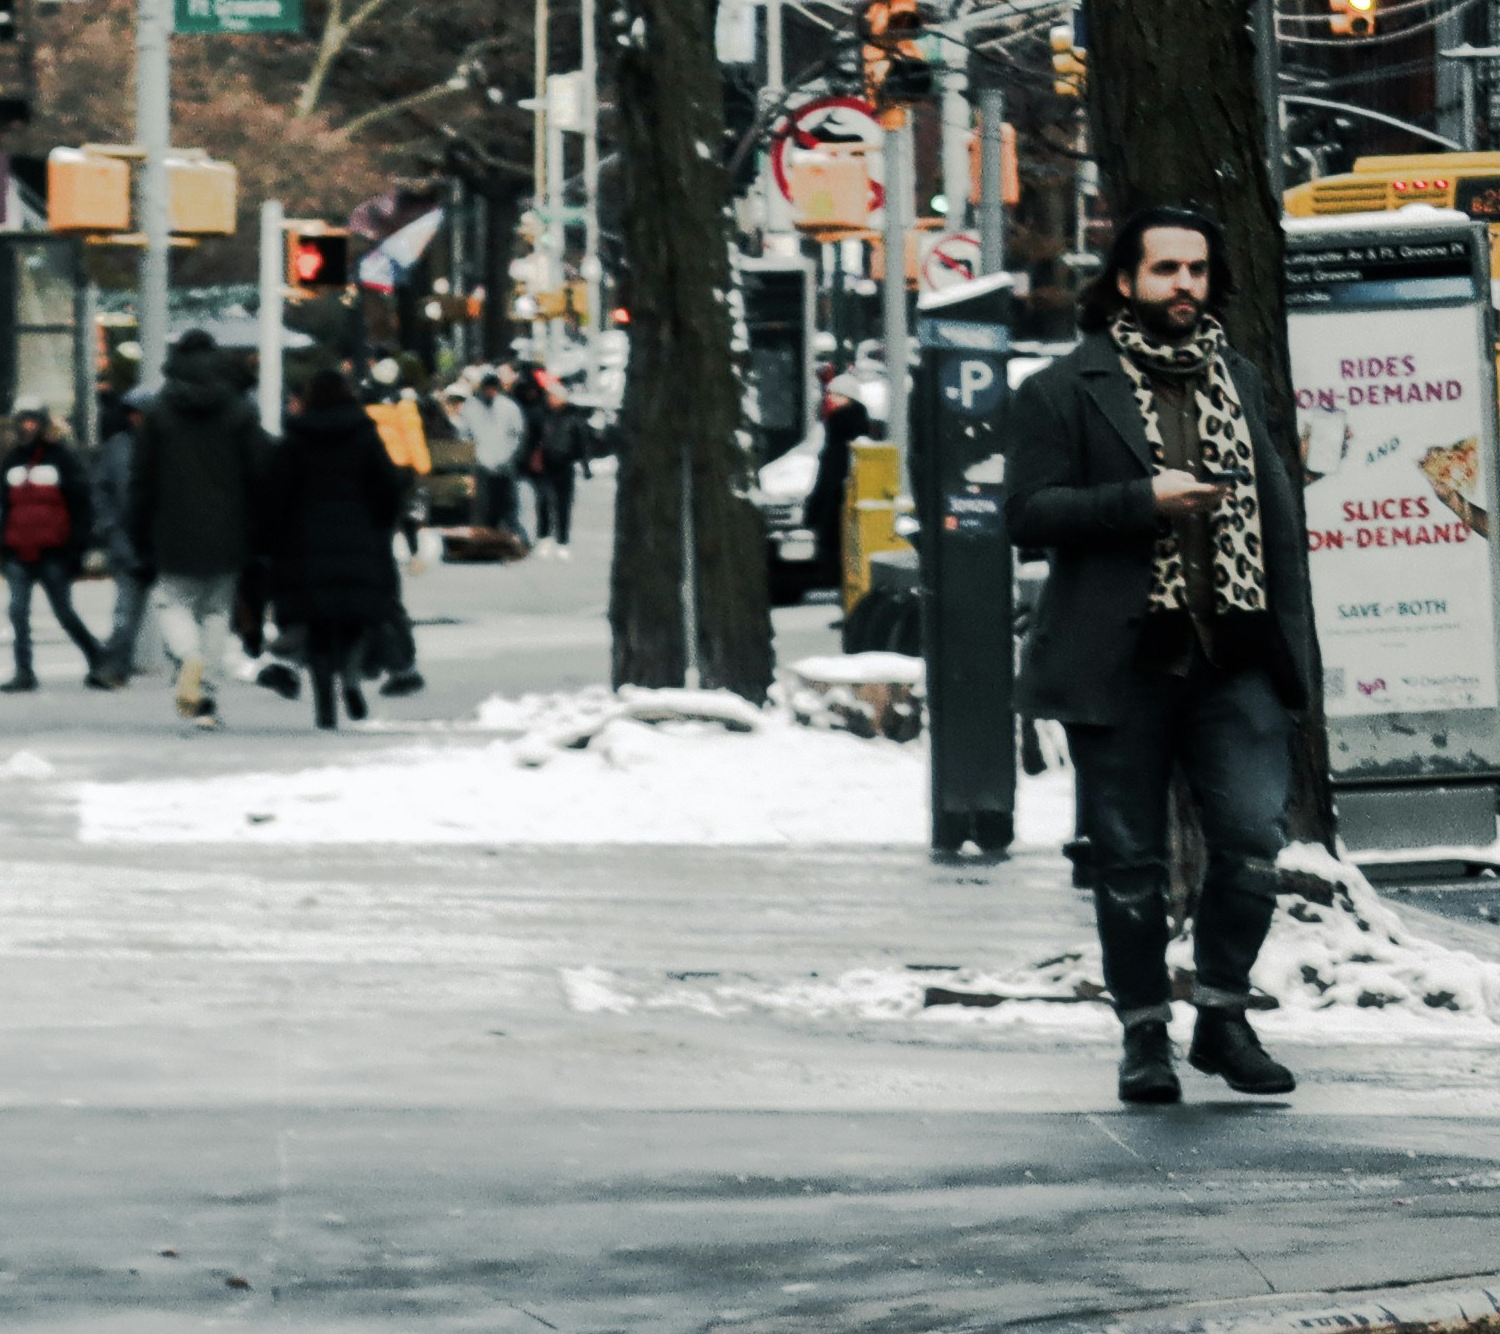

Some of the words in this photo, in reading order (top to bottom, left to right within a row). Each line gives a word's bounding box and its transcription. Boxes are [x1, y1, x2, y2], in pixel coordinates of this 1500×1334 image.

[1340, 355, 1416, 379] RIDES
[961, 360, 994, 408] P
[1296, 380, 1463, 410] ON-DEMAND
[1365, 437, 1400, 464] AND
[1342, 496, 1430, 522] SLICES
[1307, 522, 1472, 552] ON-DEMAND
[1338, 602, 1381, 618] SAVE
[1397, 599, 1447, 616] BOTH
